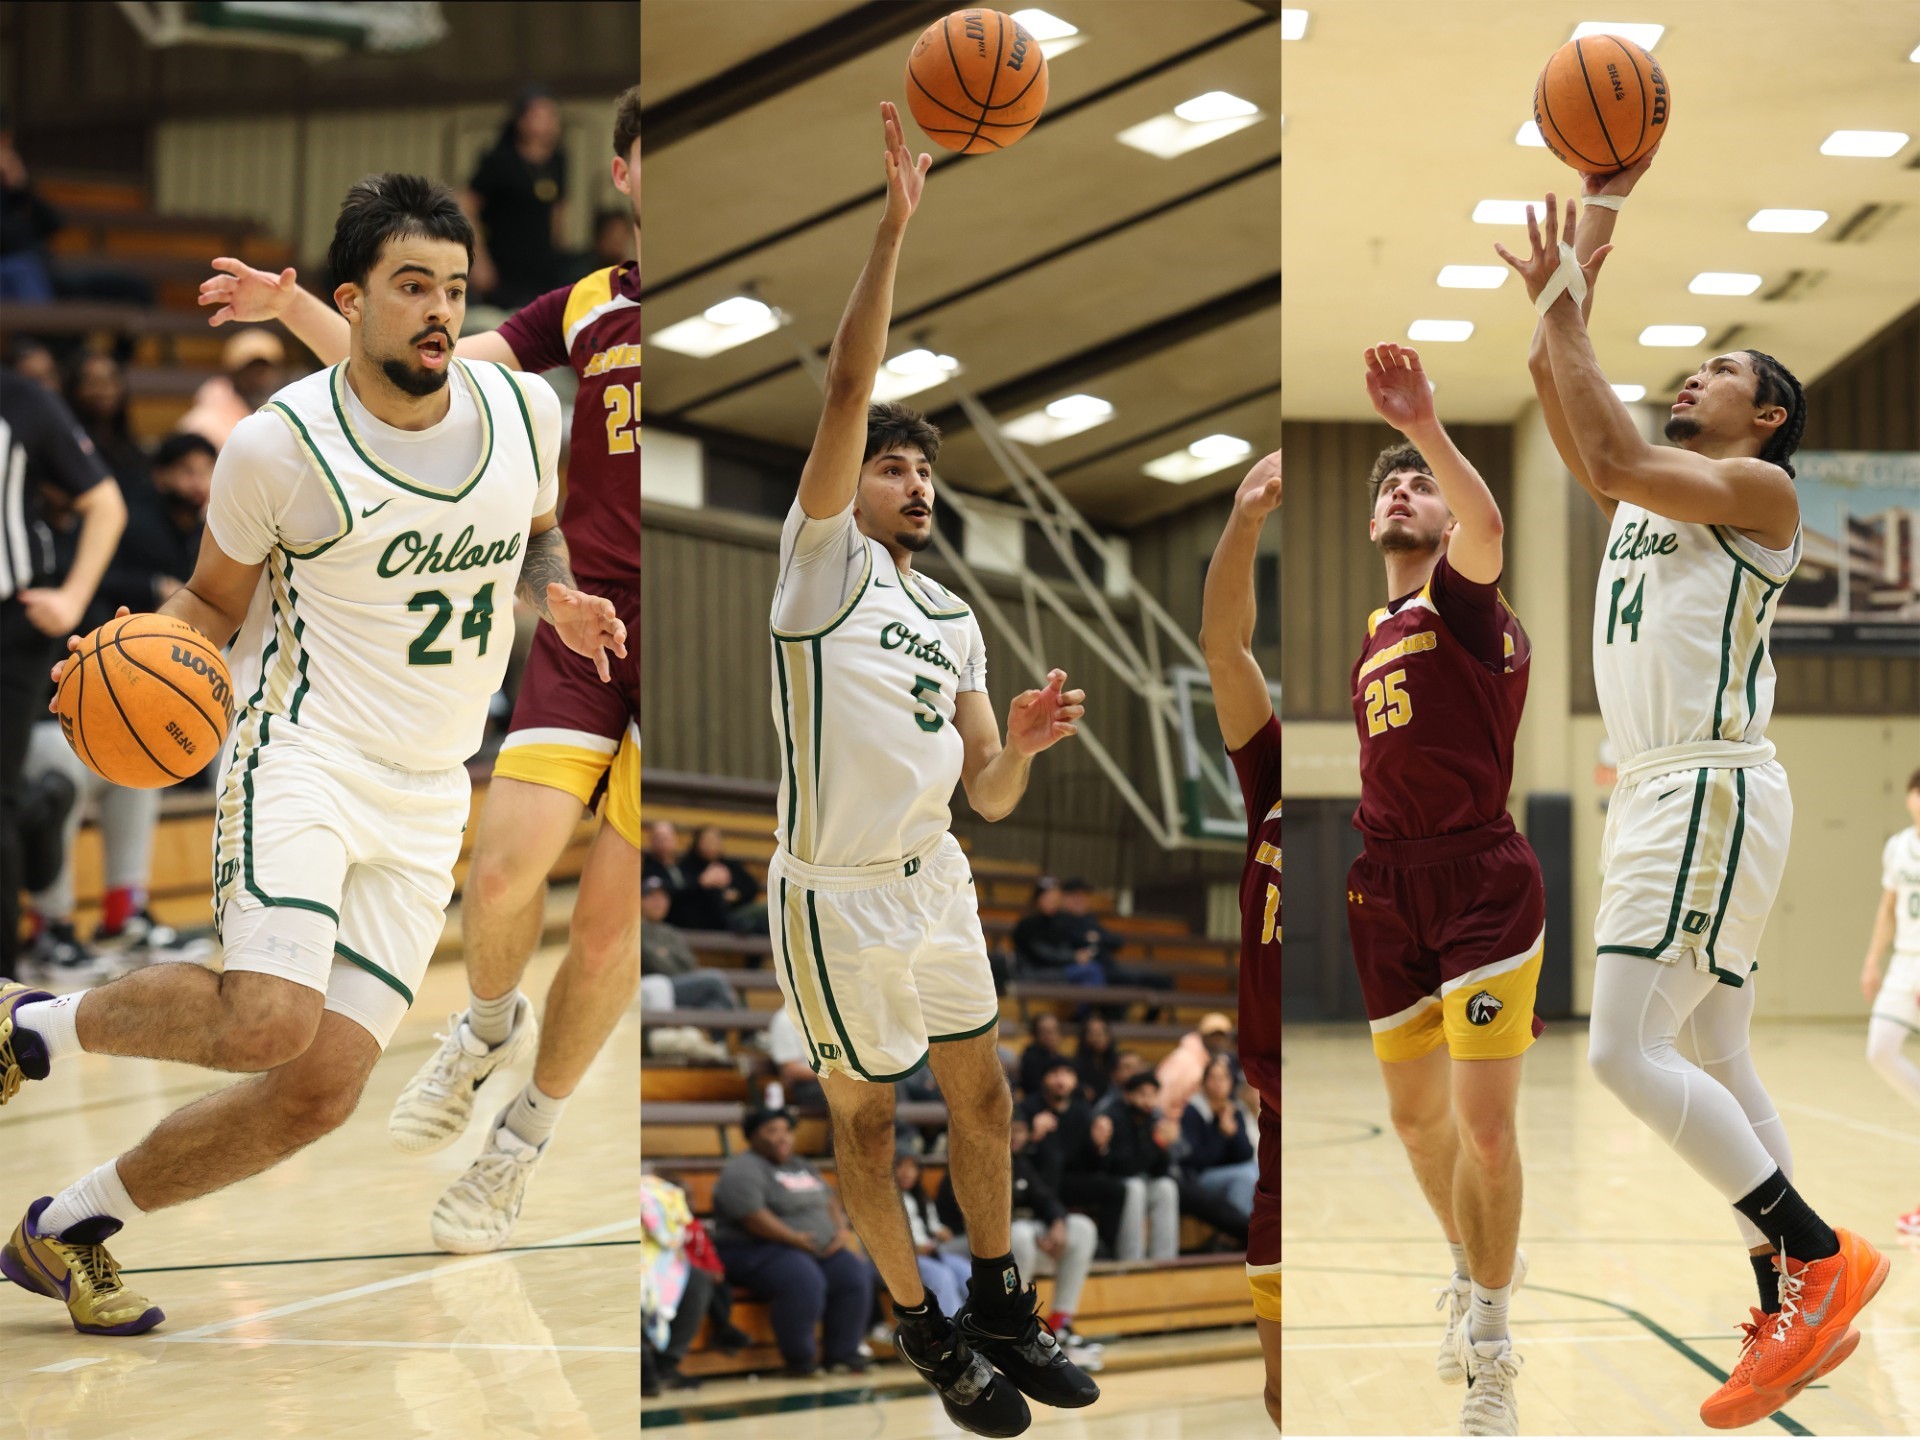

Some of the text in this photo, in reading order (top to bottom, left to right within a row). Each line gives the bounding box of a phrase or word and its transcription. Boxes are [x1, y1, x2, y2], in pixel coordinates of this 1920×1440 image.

[1607, 64, 1623, 94] NFHS
[377, 524, 521, 579] Ohlone
[406, 580, 496, 666] 24
[1606, 572, 1646, 645] 14
[910, 674, 944, 733] 5
[1364, 668, 1413, 738] 25
[165, 721, 194, 752] NFHS
